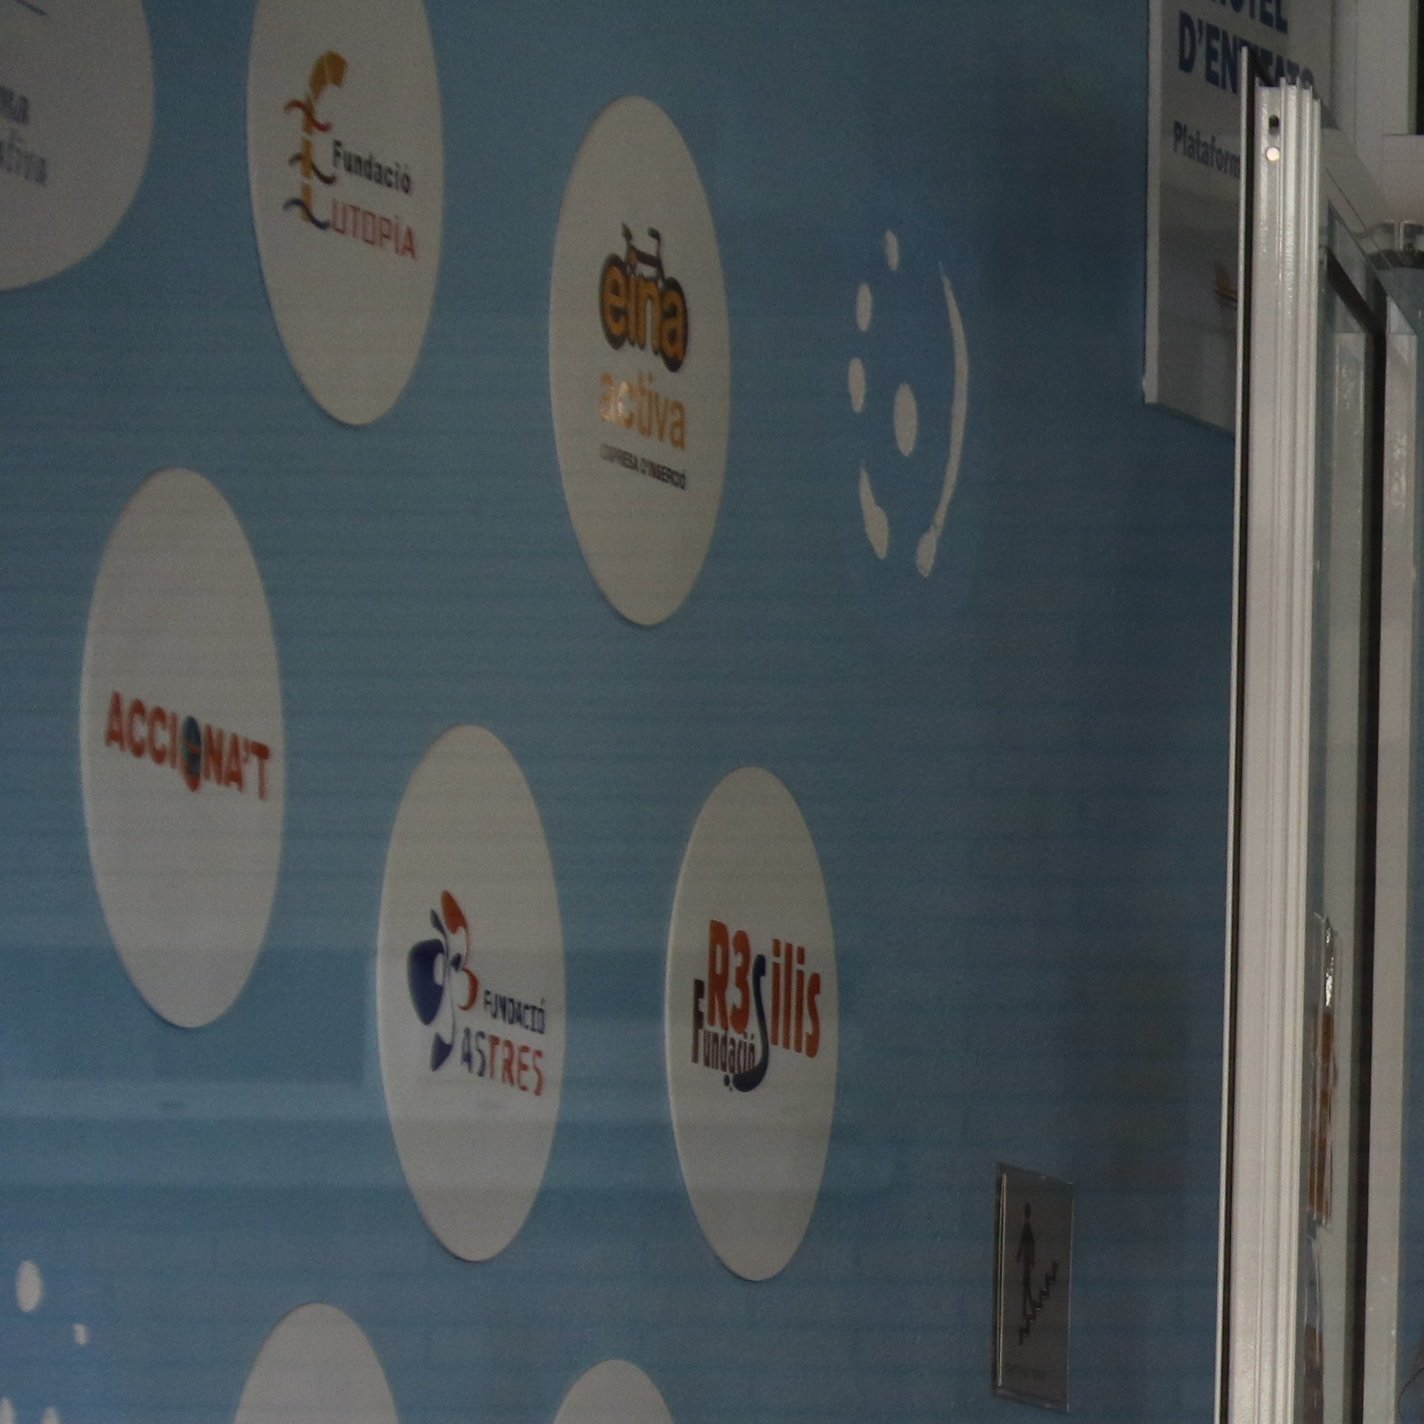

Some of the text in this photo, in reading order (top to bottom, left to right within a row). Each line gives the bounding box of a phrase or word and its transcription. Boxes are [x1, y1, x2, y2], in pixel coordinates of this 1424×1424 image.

[332, 138, 412, 194] Fundació
[599, 252, 688, 372] eina
[484, 990, 545, 1034] FUNDACIÓ
[692, 979, 757, 1073] Fundació
[460, 1026, 543, 1096] ASTRES
